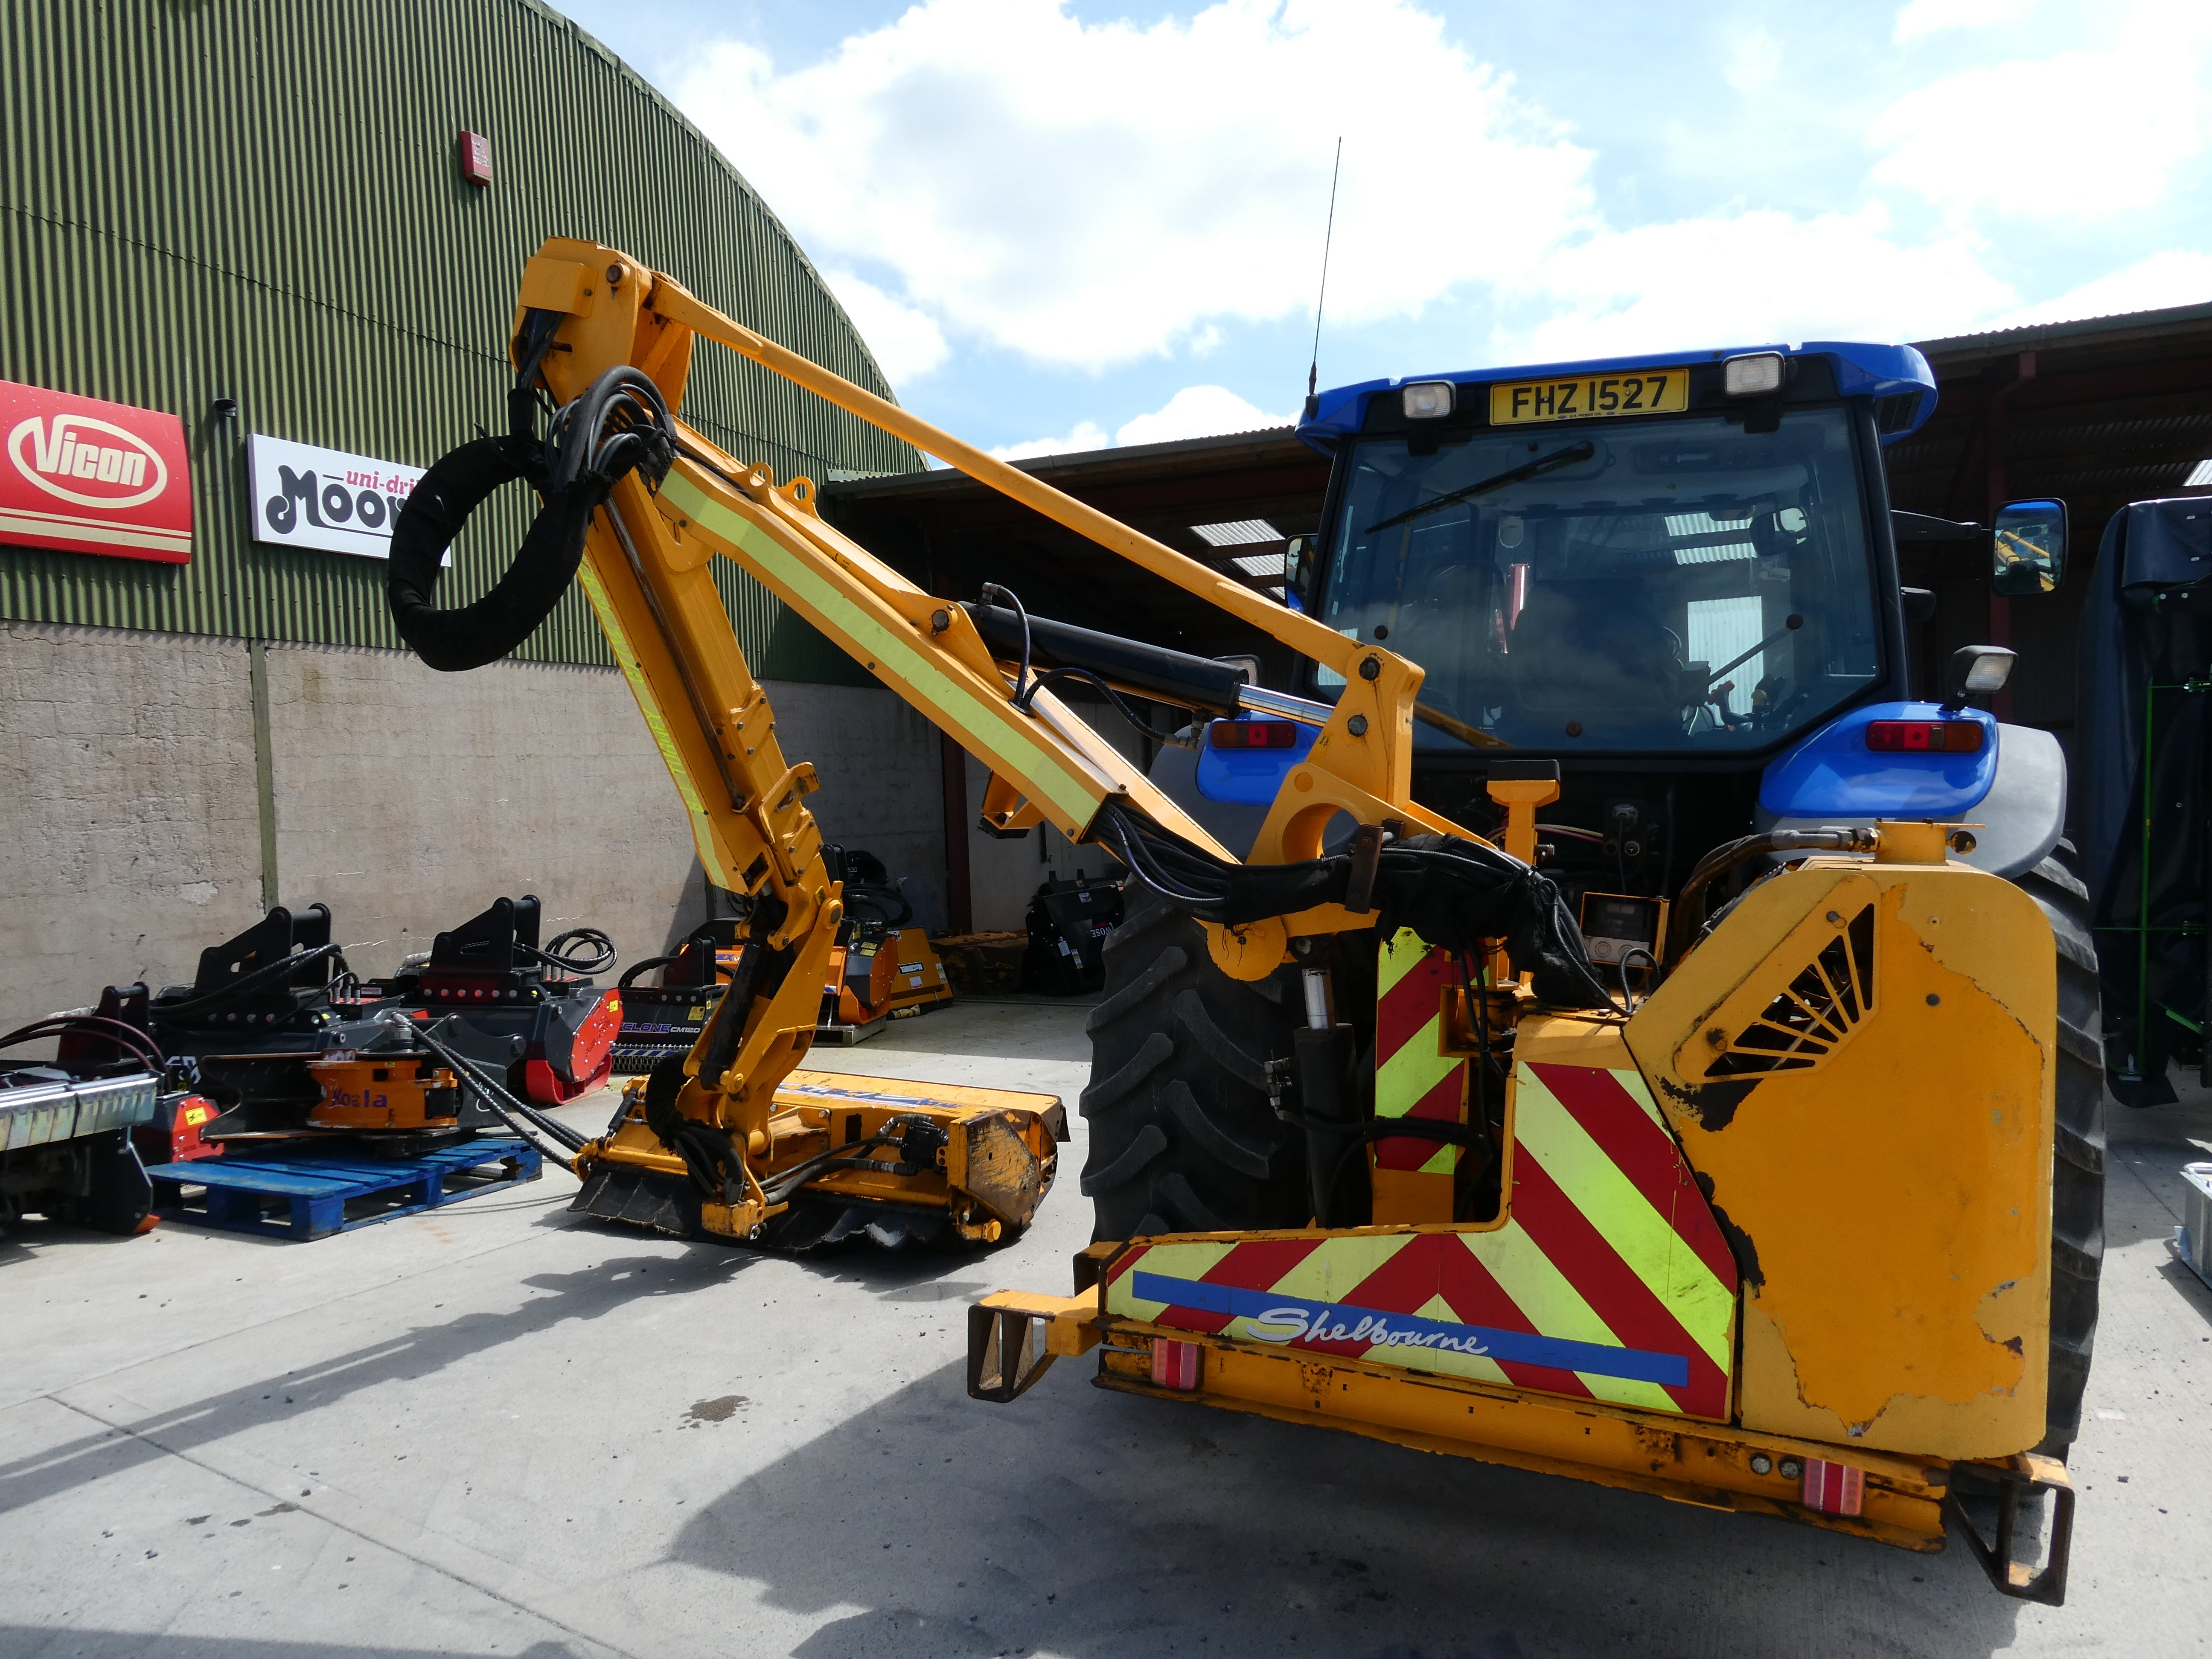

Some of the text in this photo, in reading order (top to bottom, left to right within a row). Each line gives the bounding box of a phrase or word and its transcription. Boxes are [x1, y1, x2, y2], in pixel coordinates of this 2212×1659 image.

[1512, 375, 1667, 418] FHZ 1527
[29, 416, 147, 487] Vicon
[265, 464, 407, 534] Moor
[620, 1022, 672, 1033] CLONE
[1245, 1307, 1489, 1355] Shelbourne
